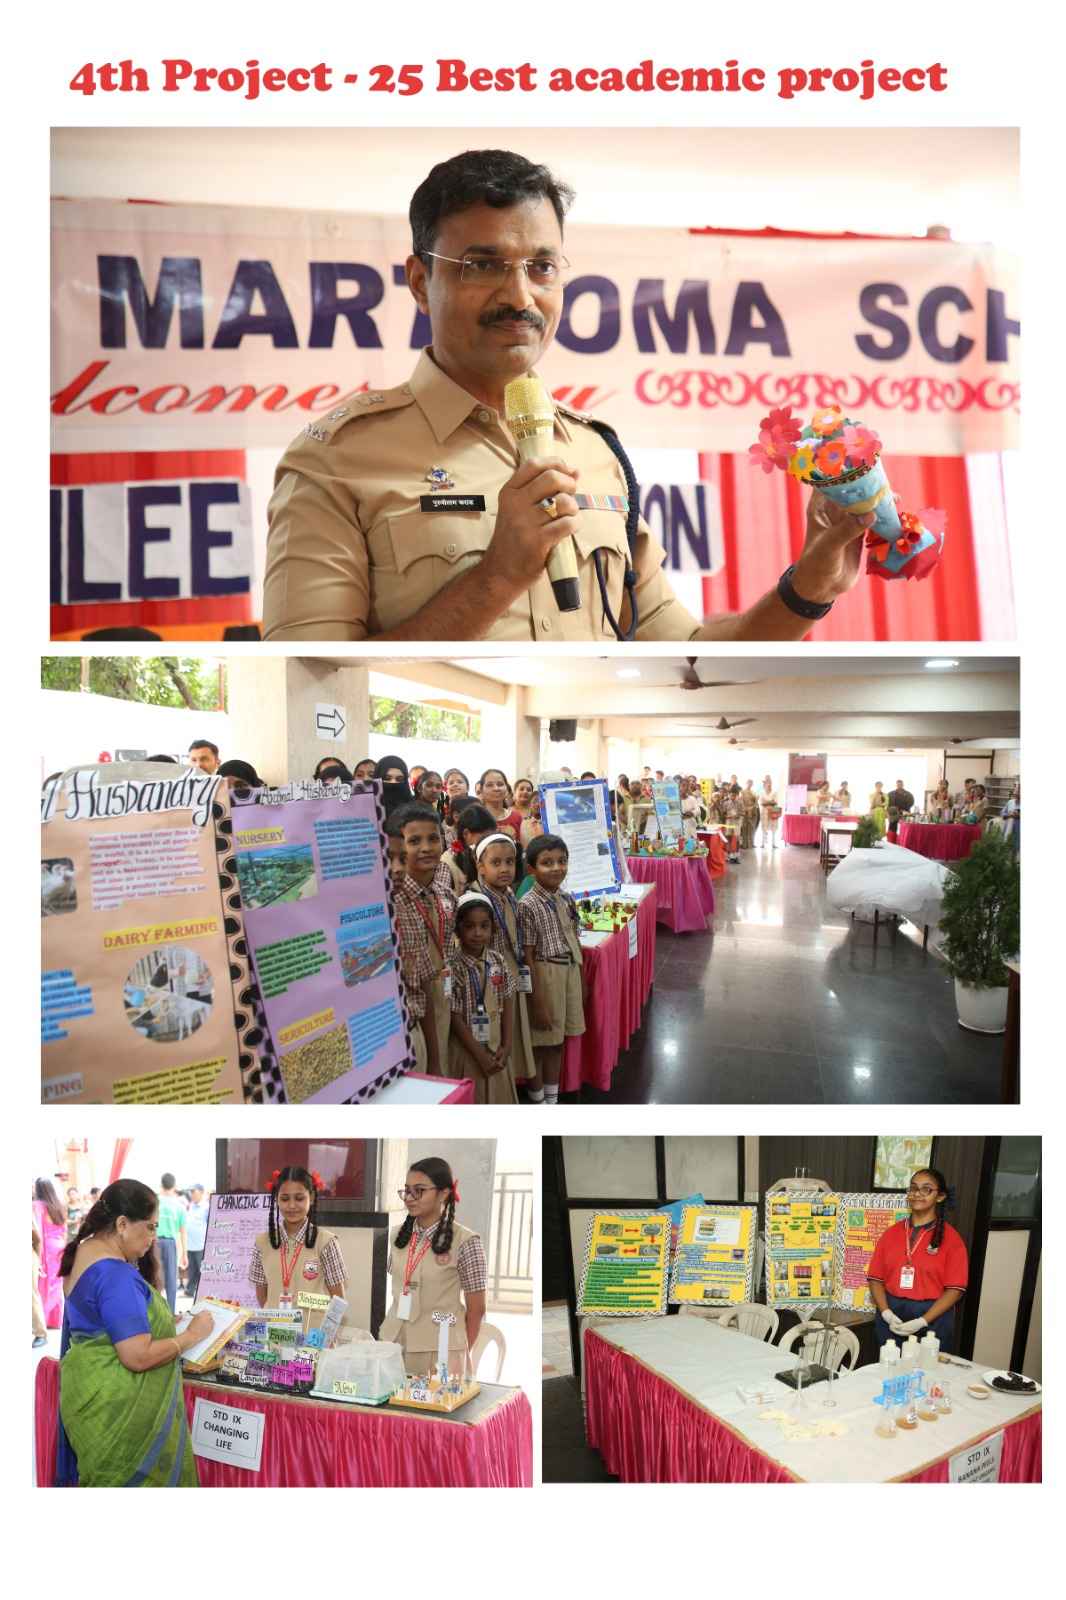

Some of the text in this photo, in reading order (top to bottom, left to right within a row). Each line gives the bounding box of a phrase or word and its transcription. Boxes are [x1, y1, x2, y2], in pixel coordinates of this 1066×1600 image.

[236, 831, 284, 846] NURSERY
[104, 922, 218, 948] DAIRY FARMING
[213, 1410, 242, 1425] STD IX
[203, 1421, 249, 1441] CHANGING
[215, 1438, 232, 1450] LIFE
[967, 1451, 981, 1466] STD
[983, 1447, 990, 1456] IX
